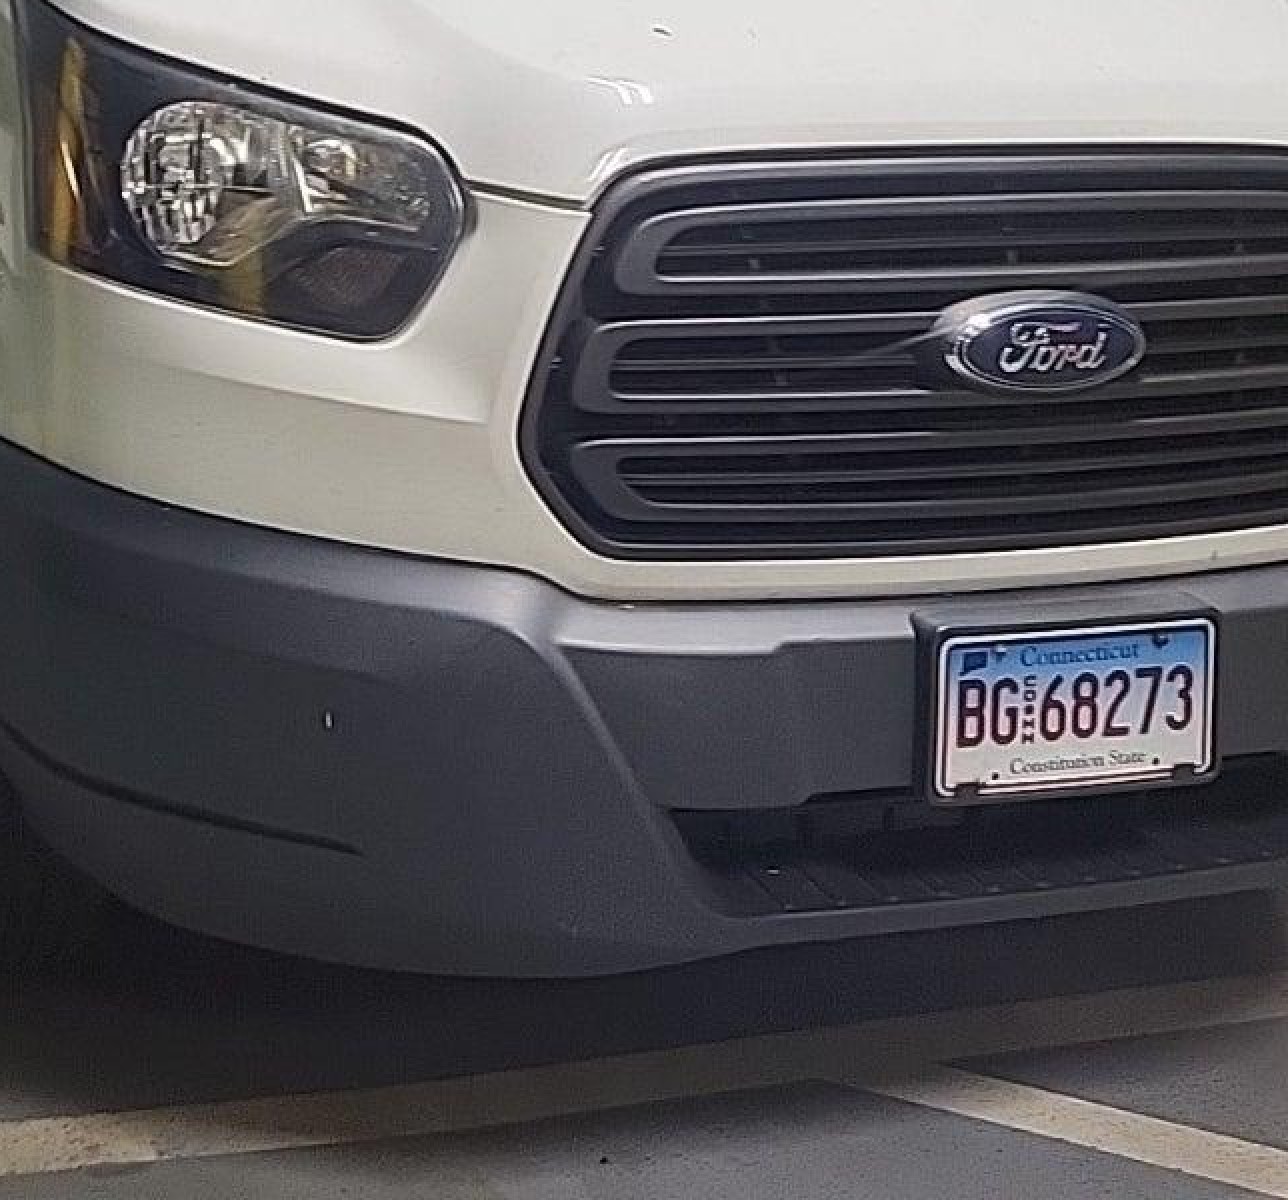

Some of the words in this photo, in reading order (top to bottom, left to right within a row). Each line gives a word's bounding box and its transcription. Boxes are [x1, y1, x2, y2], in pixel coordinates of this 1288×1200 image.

[998, 320, 1107, 374] Ford
[1019, 643, 1140, 667] Connecticut
[1009, 752, 1105, 775] Constitution
[1108, 748, 1148, 767] State
